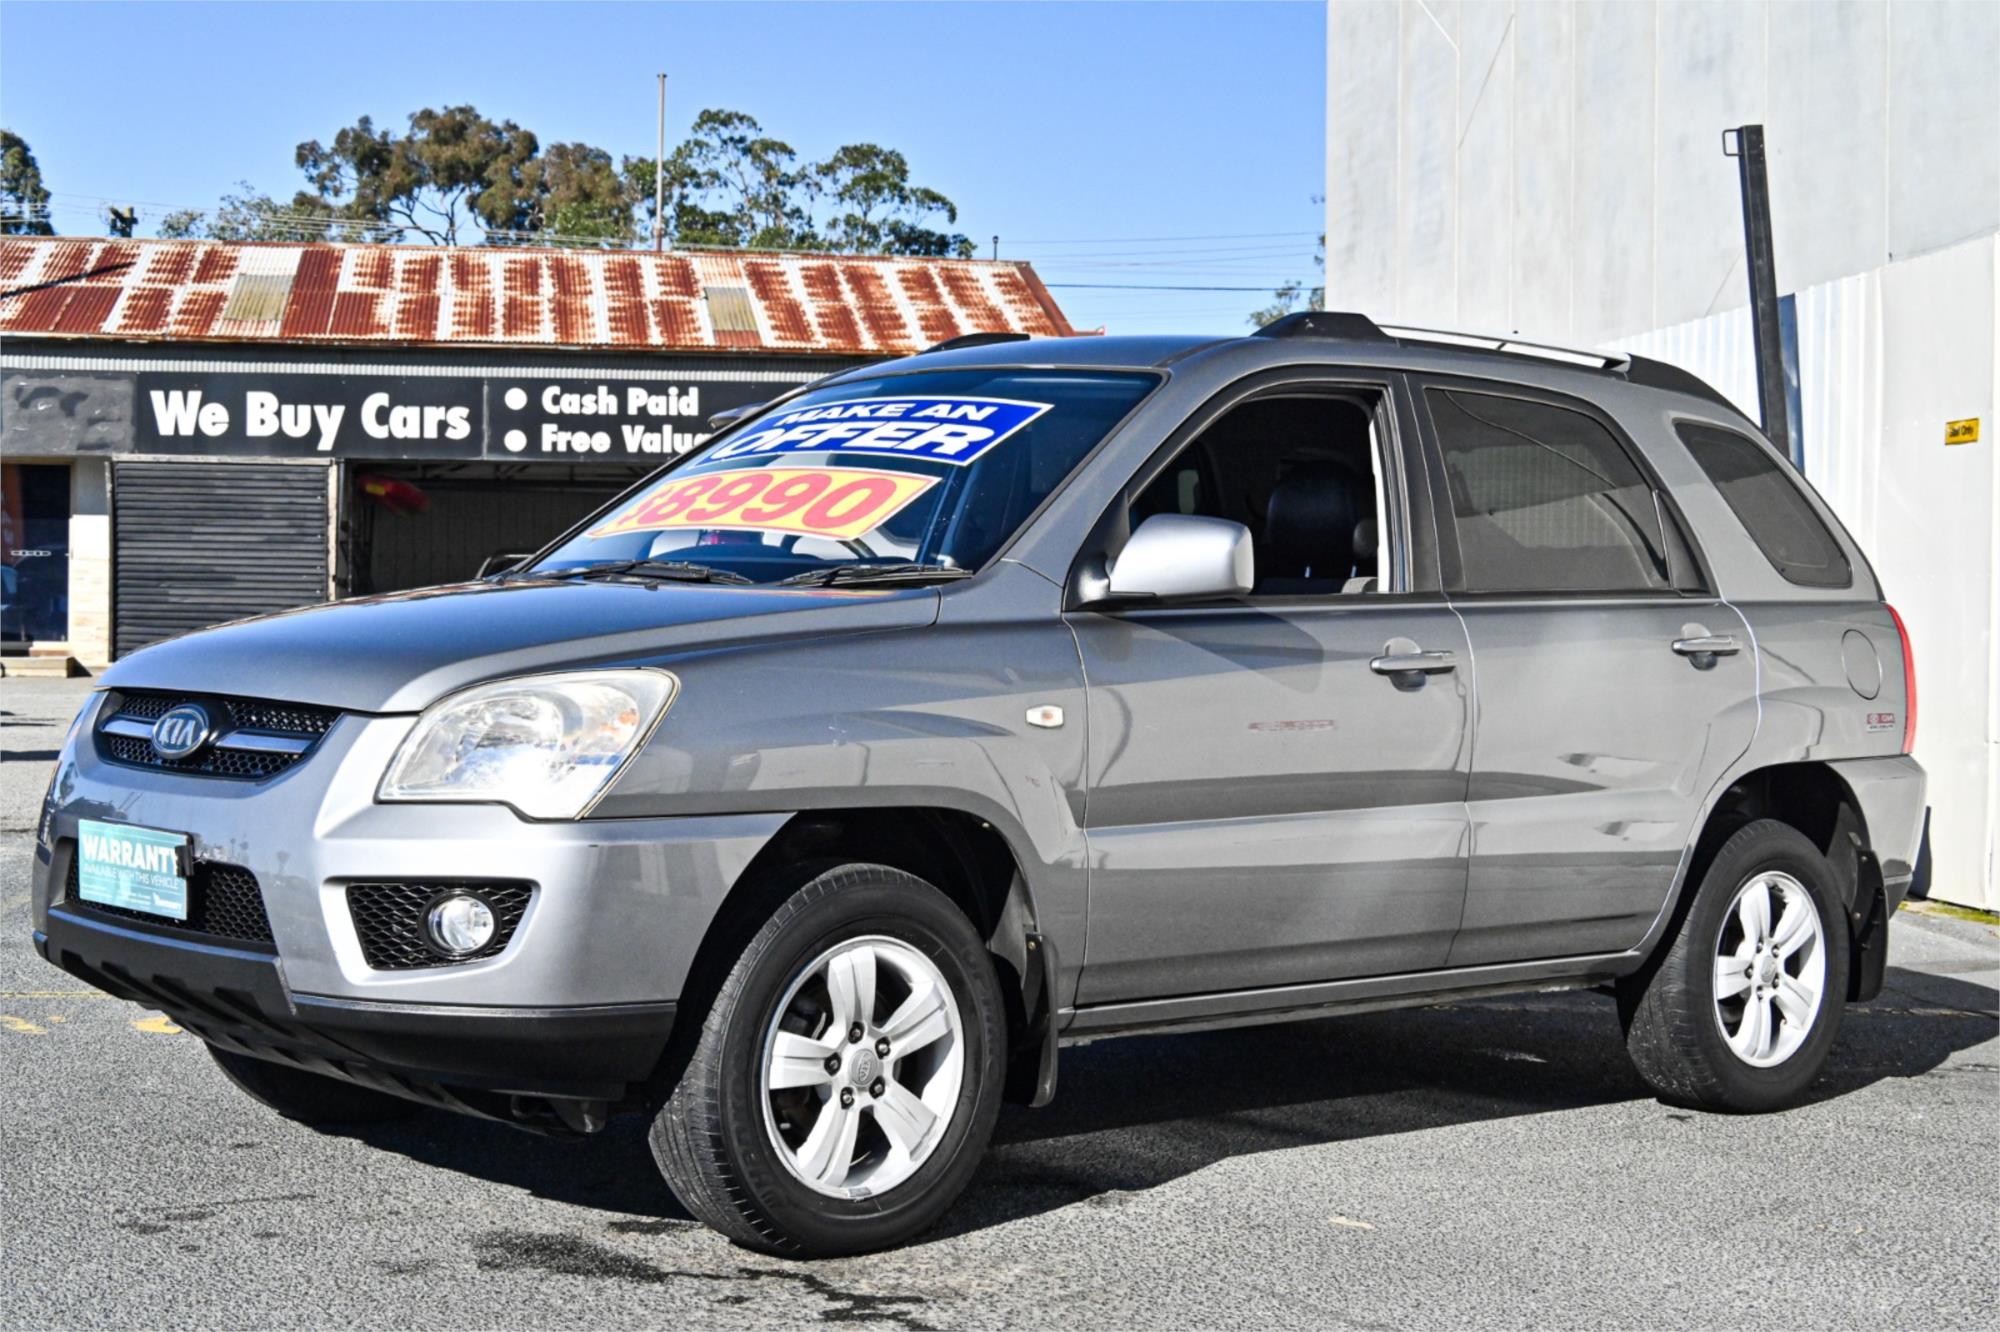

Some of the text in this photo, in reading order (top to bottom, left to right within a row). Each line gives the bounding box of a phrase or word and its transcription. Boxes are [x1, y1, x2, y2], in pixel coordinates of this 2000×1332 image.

[541, 385, 699, 416] Cash Paid
[773, 403, 998, 427] MAKE AN
[150, 390, 471, 451] We Buy Cars
[541, 423, 611, 453] Free
[710, 420, 995, 459] OFFER
[158, 718, 195, 746] KIA
[151, 874, 179, 891] VEHICLE
